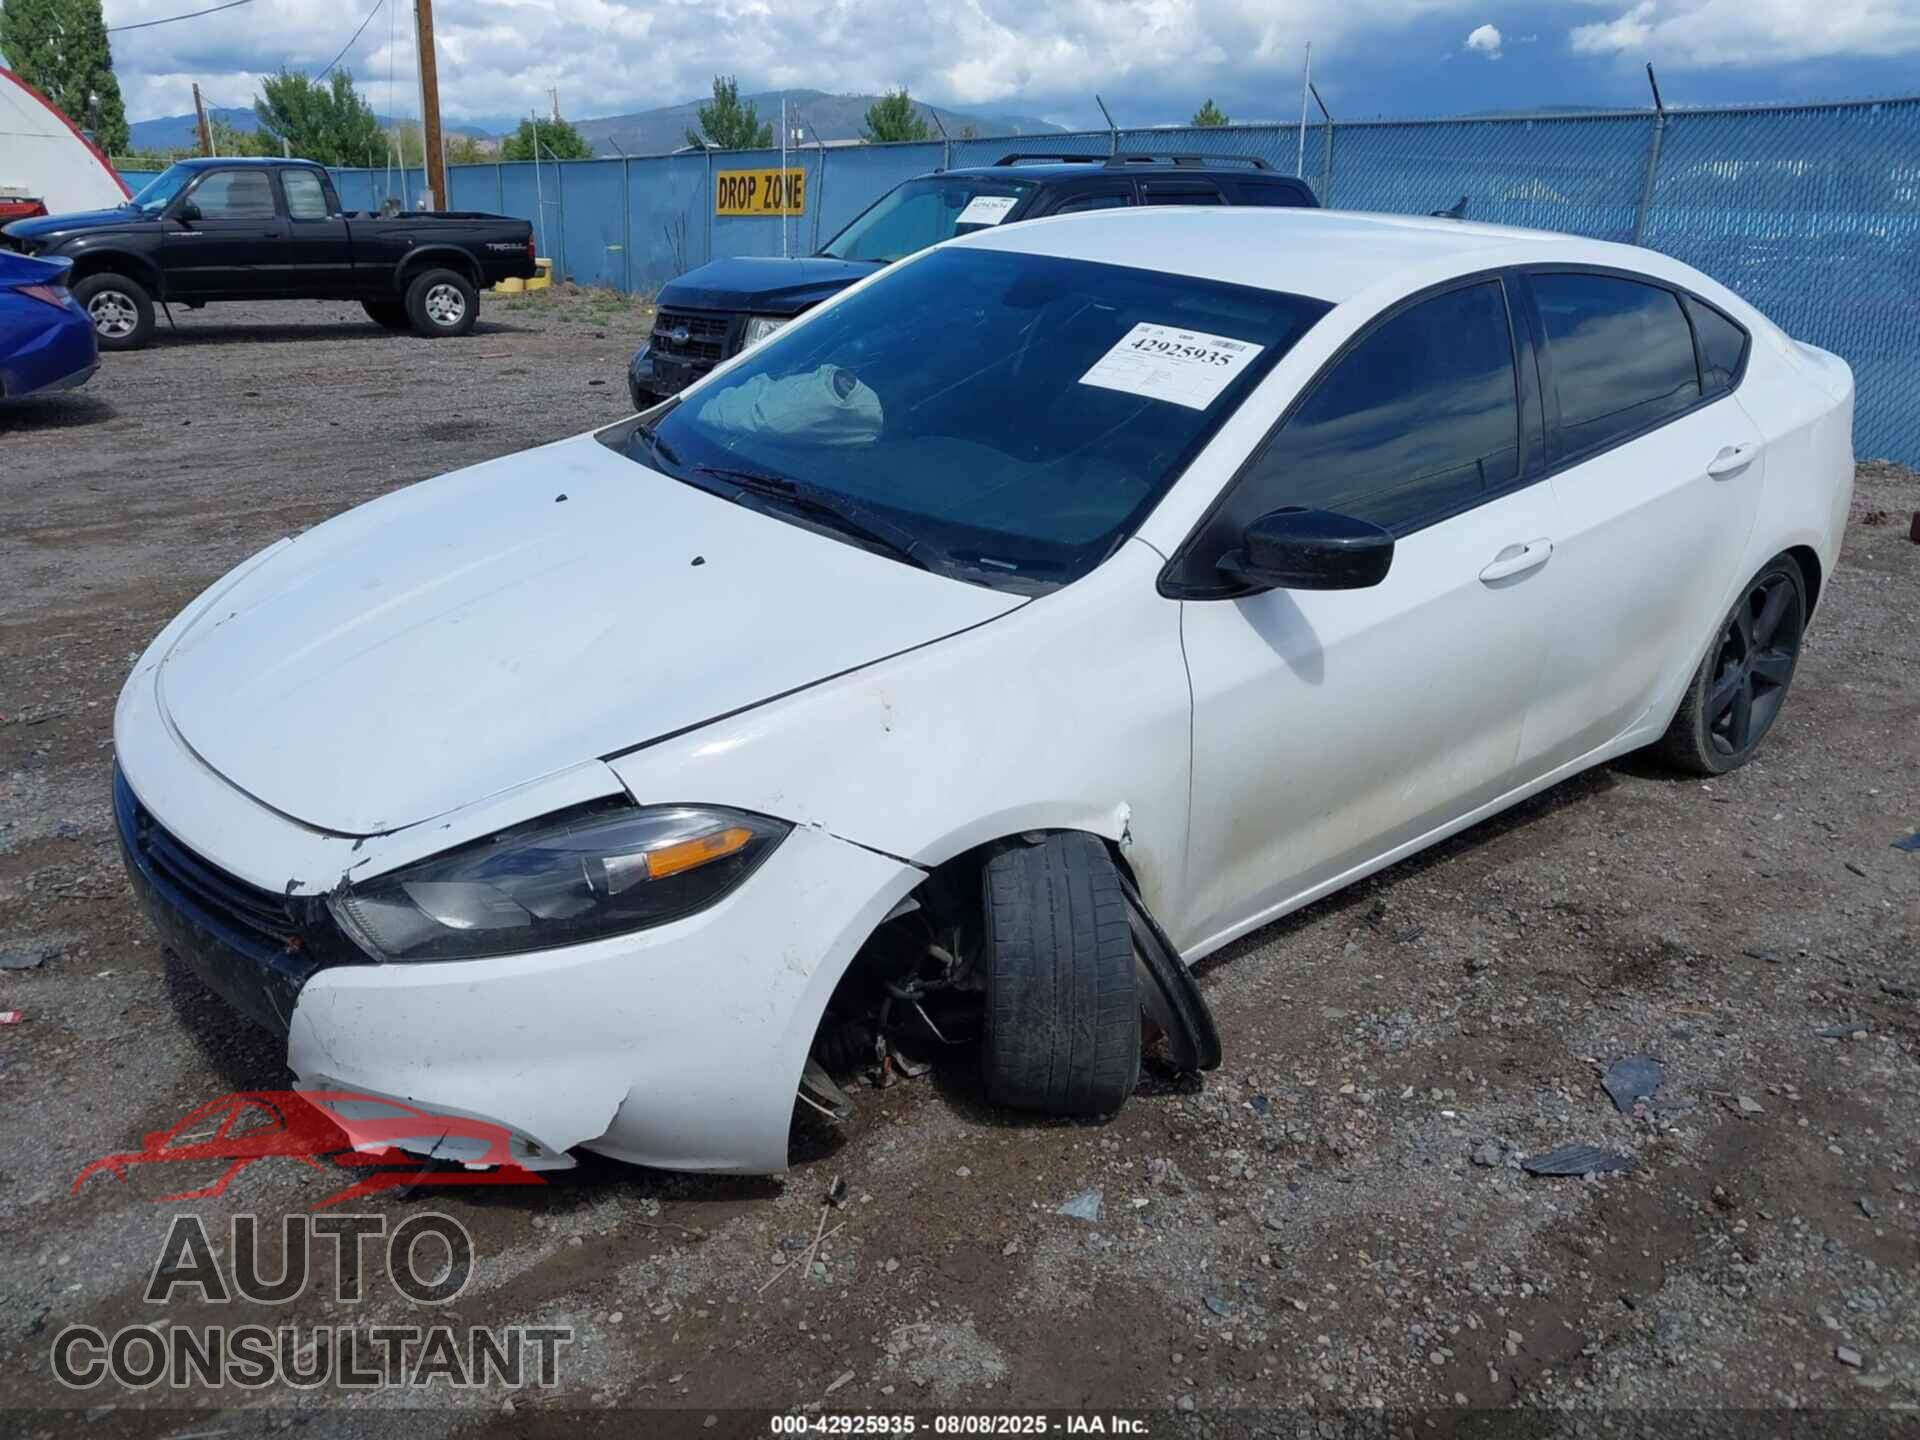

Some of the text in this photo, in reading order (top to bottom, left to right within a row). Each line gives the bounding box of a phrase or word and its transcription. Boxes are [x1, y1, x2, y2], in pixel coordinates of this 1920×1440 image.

[719, 173, 802, 209] DROP ZONE
[1131, 338, 1234, 367] 42925935
